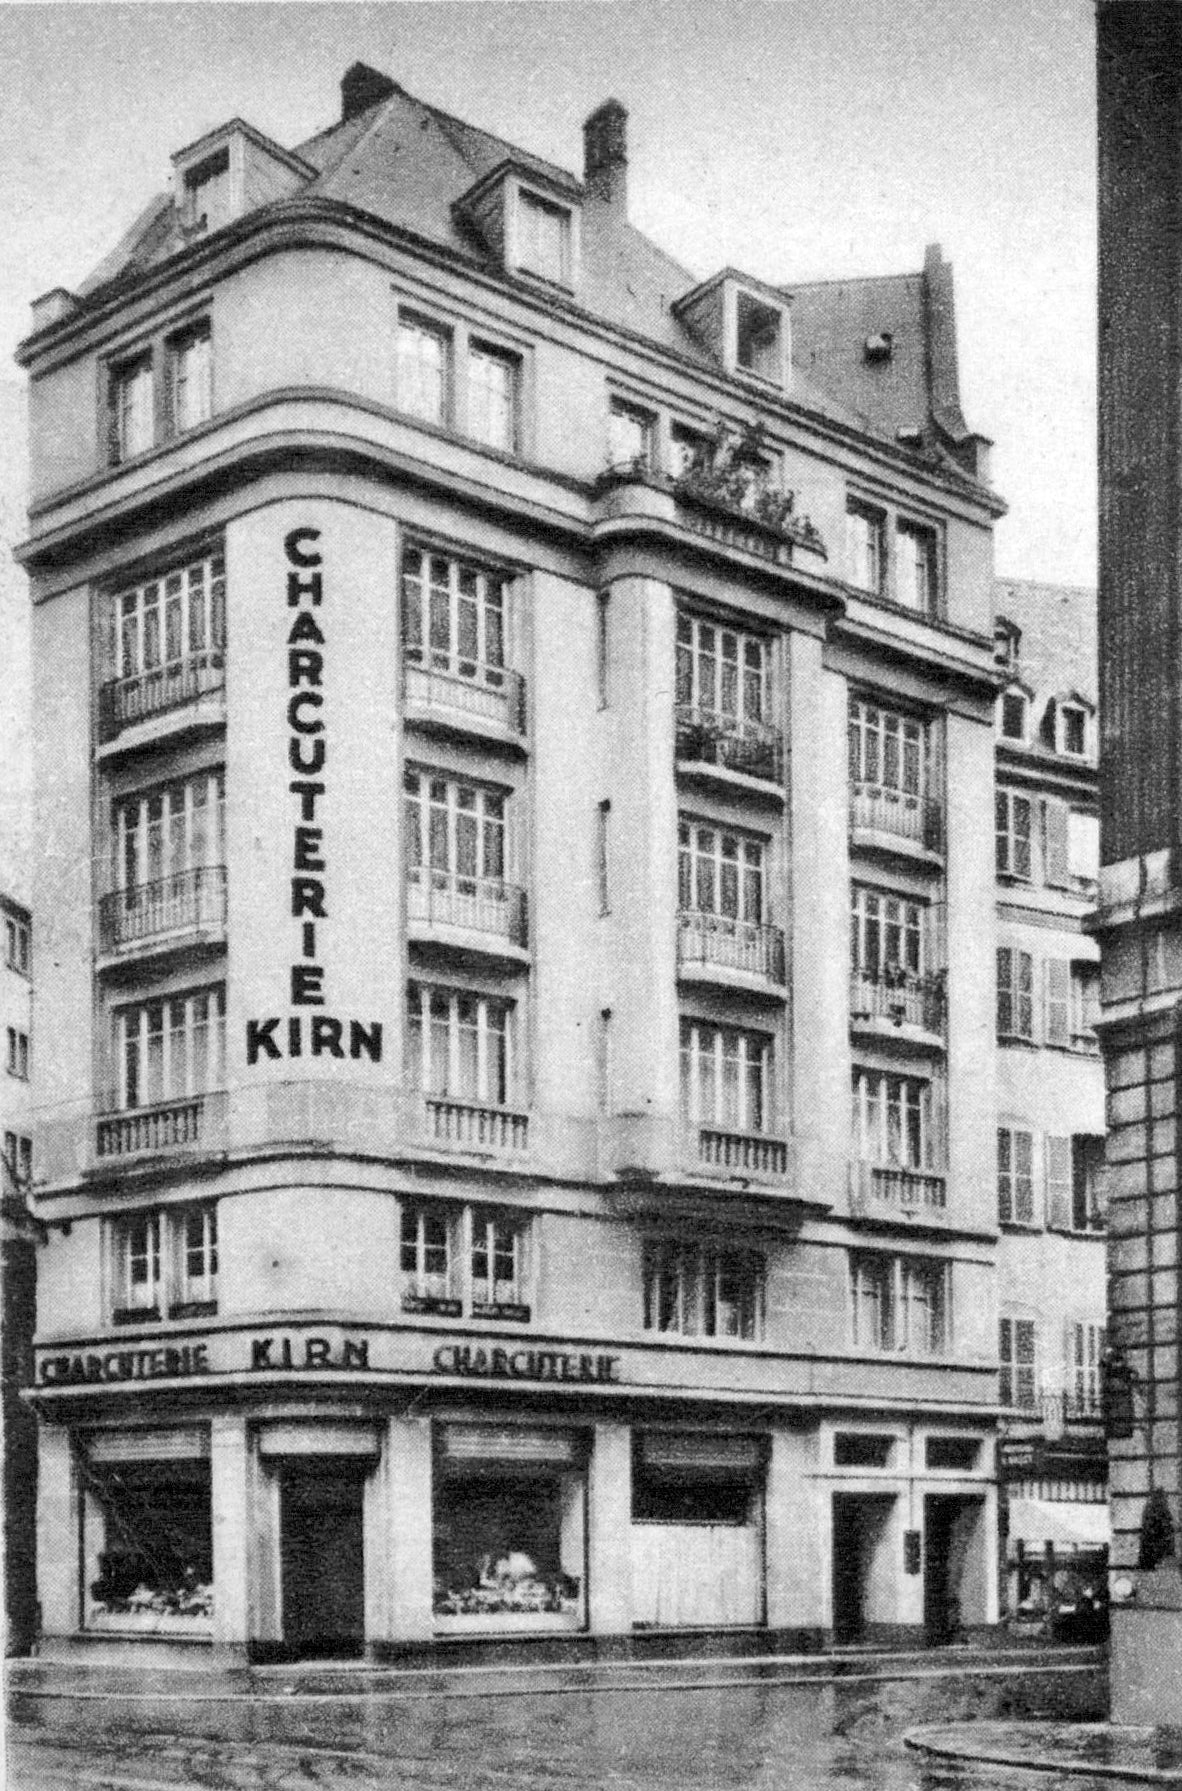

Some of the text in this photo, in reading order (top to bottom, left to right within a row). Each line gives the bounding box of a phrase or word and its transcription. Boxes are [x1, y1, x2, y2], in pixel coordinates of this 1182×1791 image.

[284, 527, 328, 1005] CHARCUTERIE
[247, 1015, 382, 1066] KIRN
[41, 1338, 620, 1384] CHARCUTERIE KIRN CHARCUTERIE
